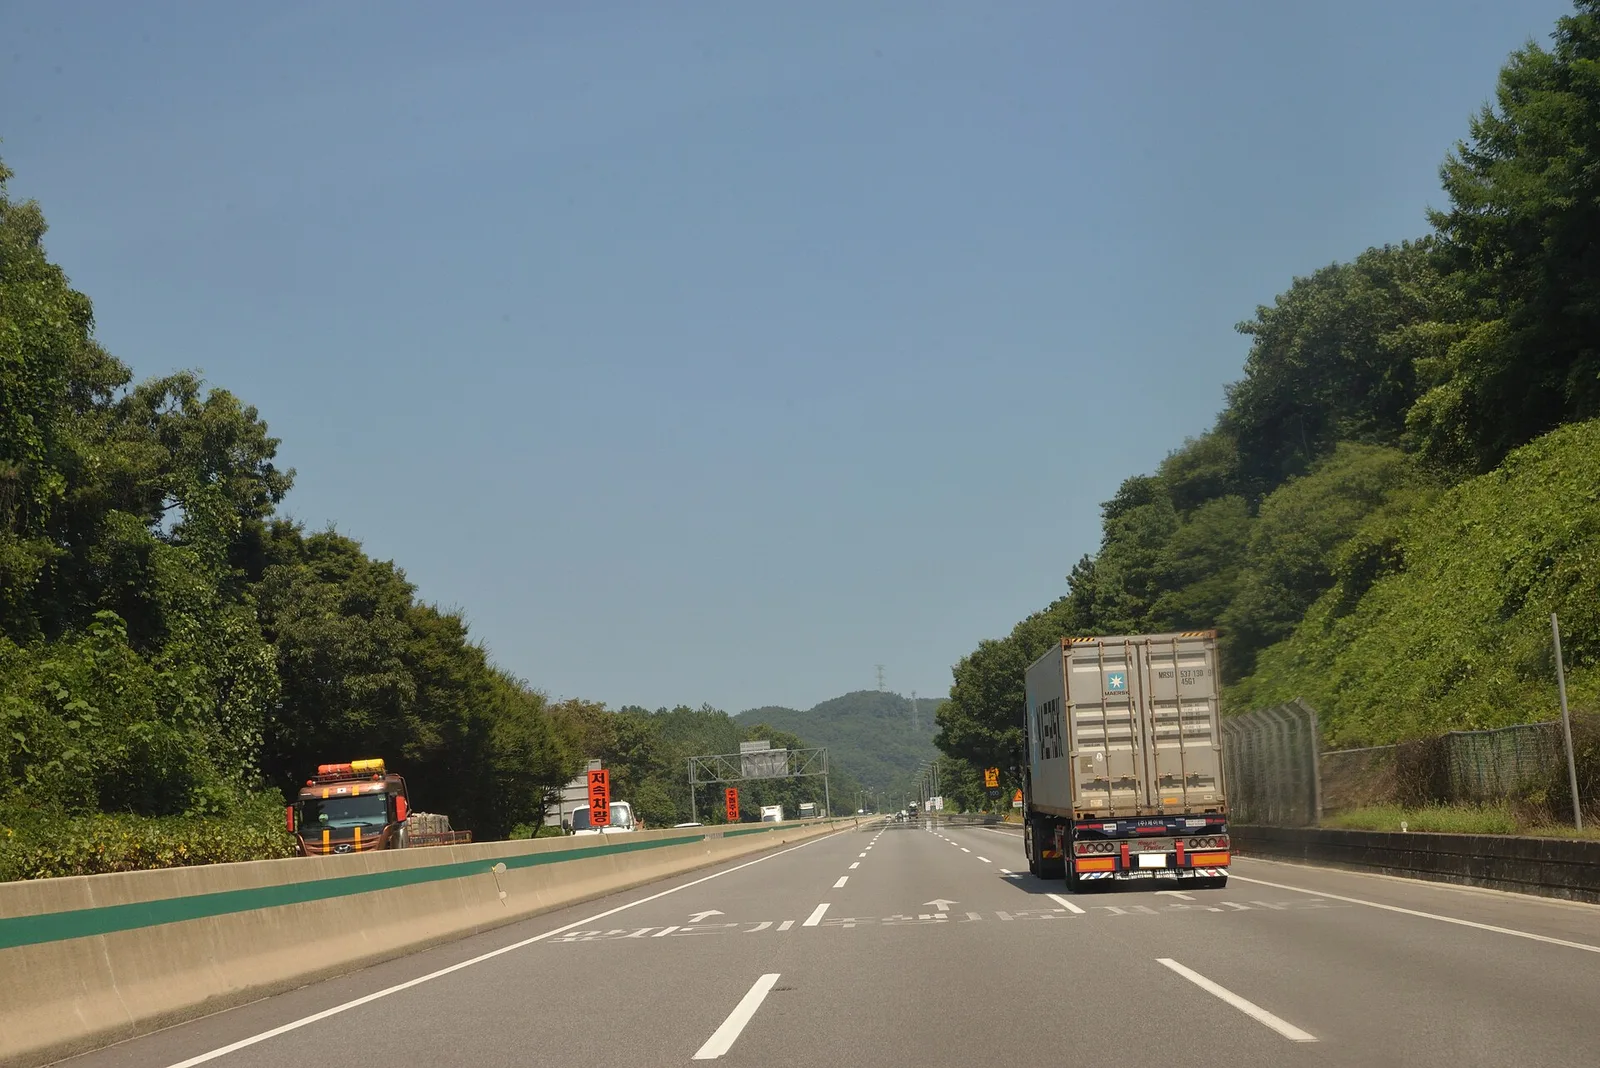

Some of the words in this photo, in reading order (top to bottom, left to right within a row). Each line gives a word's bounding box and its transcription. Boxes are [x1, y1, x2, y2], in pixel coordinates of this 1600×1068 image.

[1158, 671, 1174, 679] MRSU
[1181, 677, 1196, 685] 45G1
[591, 772, 607, 823] 저속차량
[547, 920, 796, 943] 앞지르기
